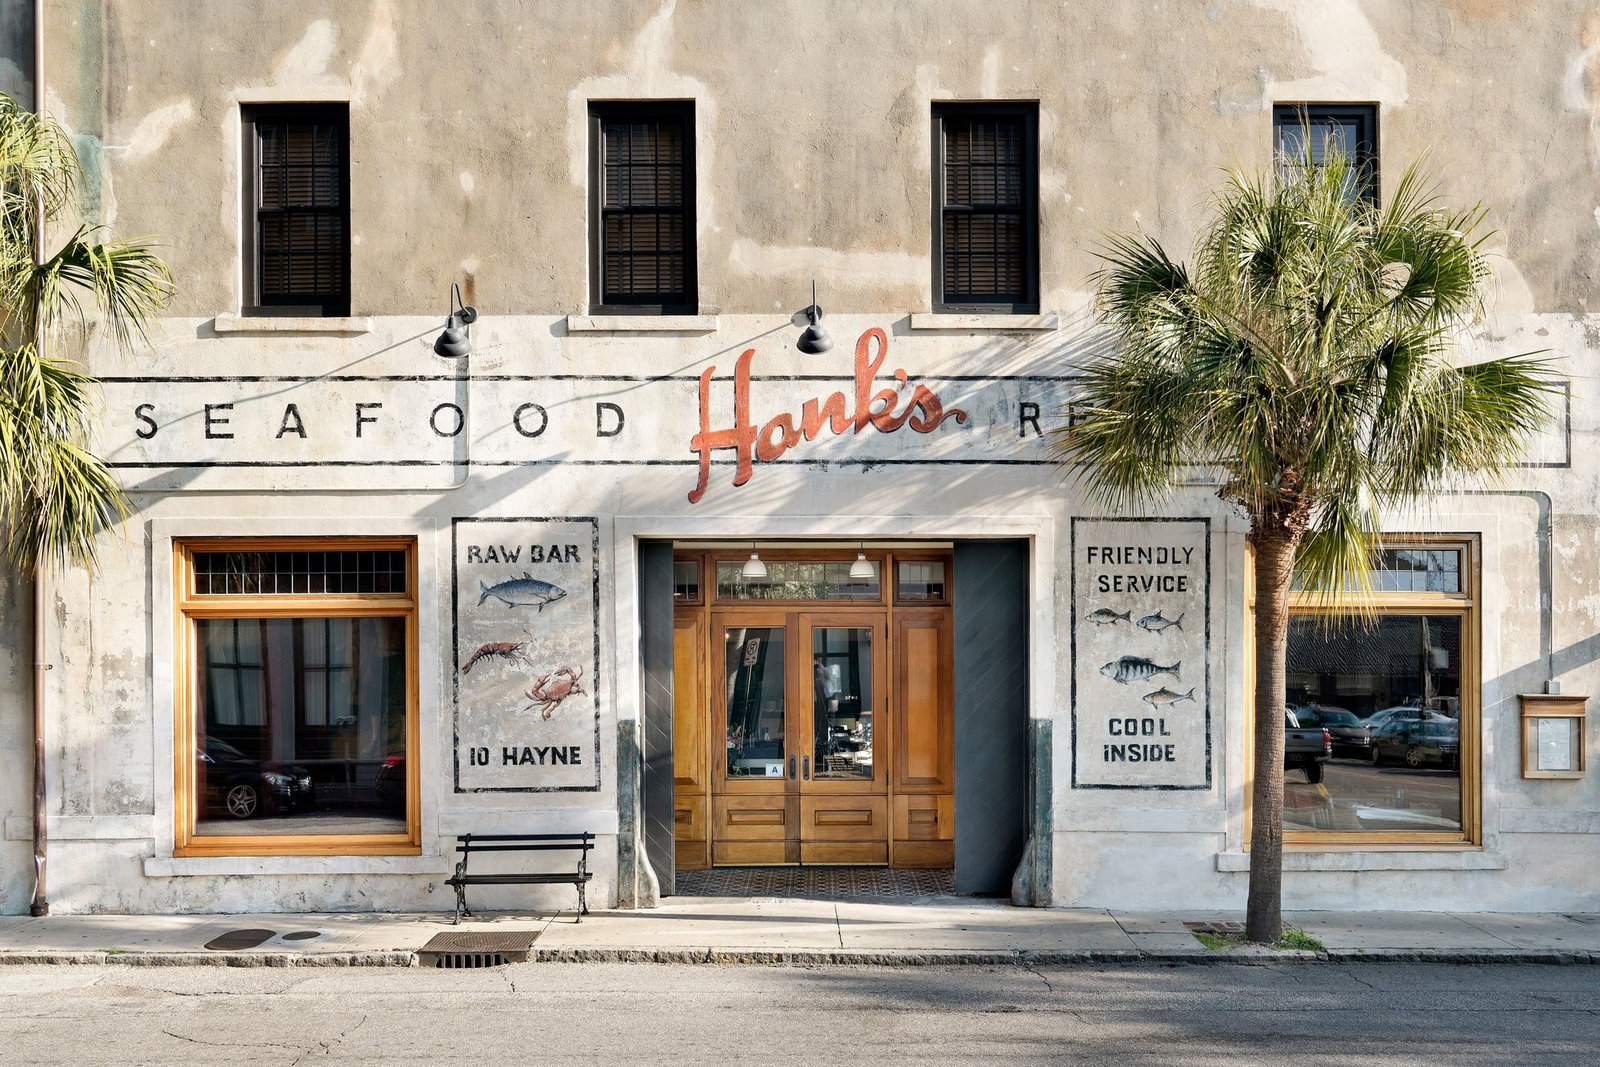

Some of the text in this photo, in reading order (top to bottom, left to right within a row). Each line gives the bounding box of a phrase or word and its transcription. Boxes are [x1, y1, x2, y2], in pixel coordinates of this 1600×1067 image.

[135, 402, 624, 440] SEAFOOD
[688, 327, 967, 504] Hank's
[467, 544, 581, 564] RAW BAR
[1087, 546, 1194, 565] FRIENDLY
[1098, 575, 1187, 593] SERVICE
[1108, 718, 1171, 736] COOL
[470, 746, 582, 766] 10 HAYNE
[1103, 743, 1176, 762] INSIDE
[771, 766, 779, 774] A
